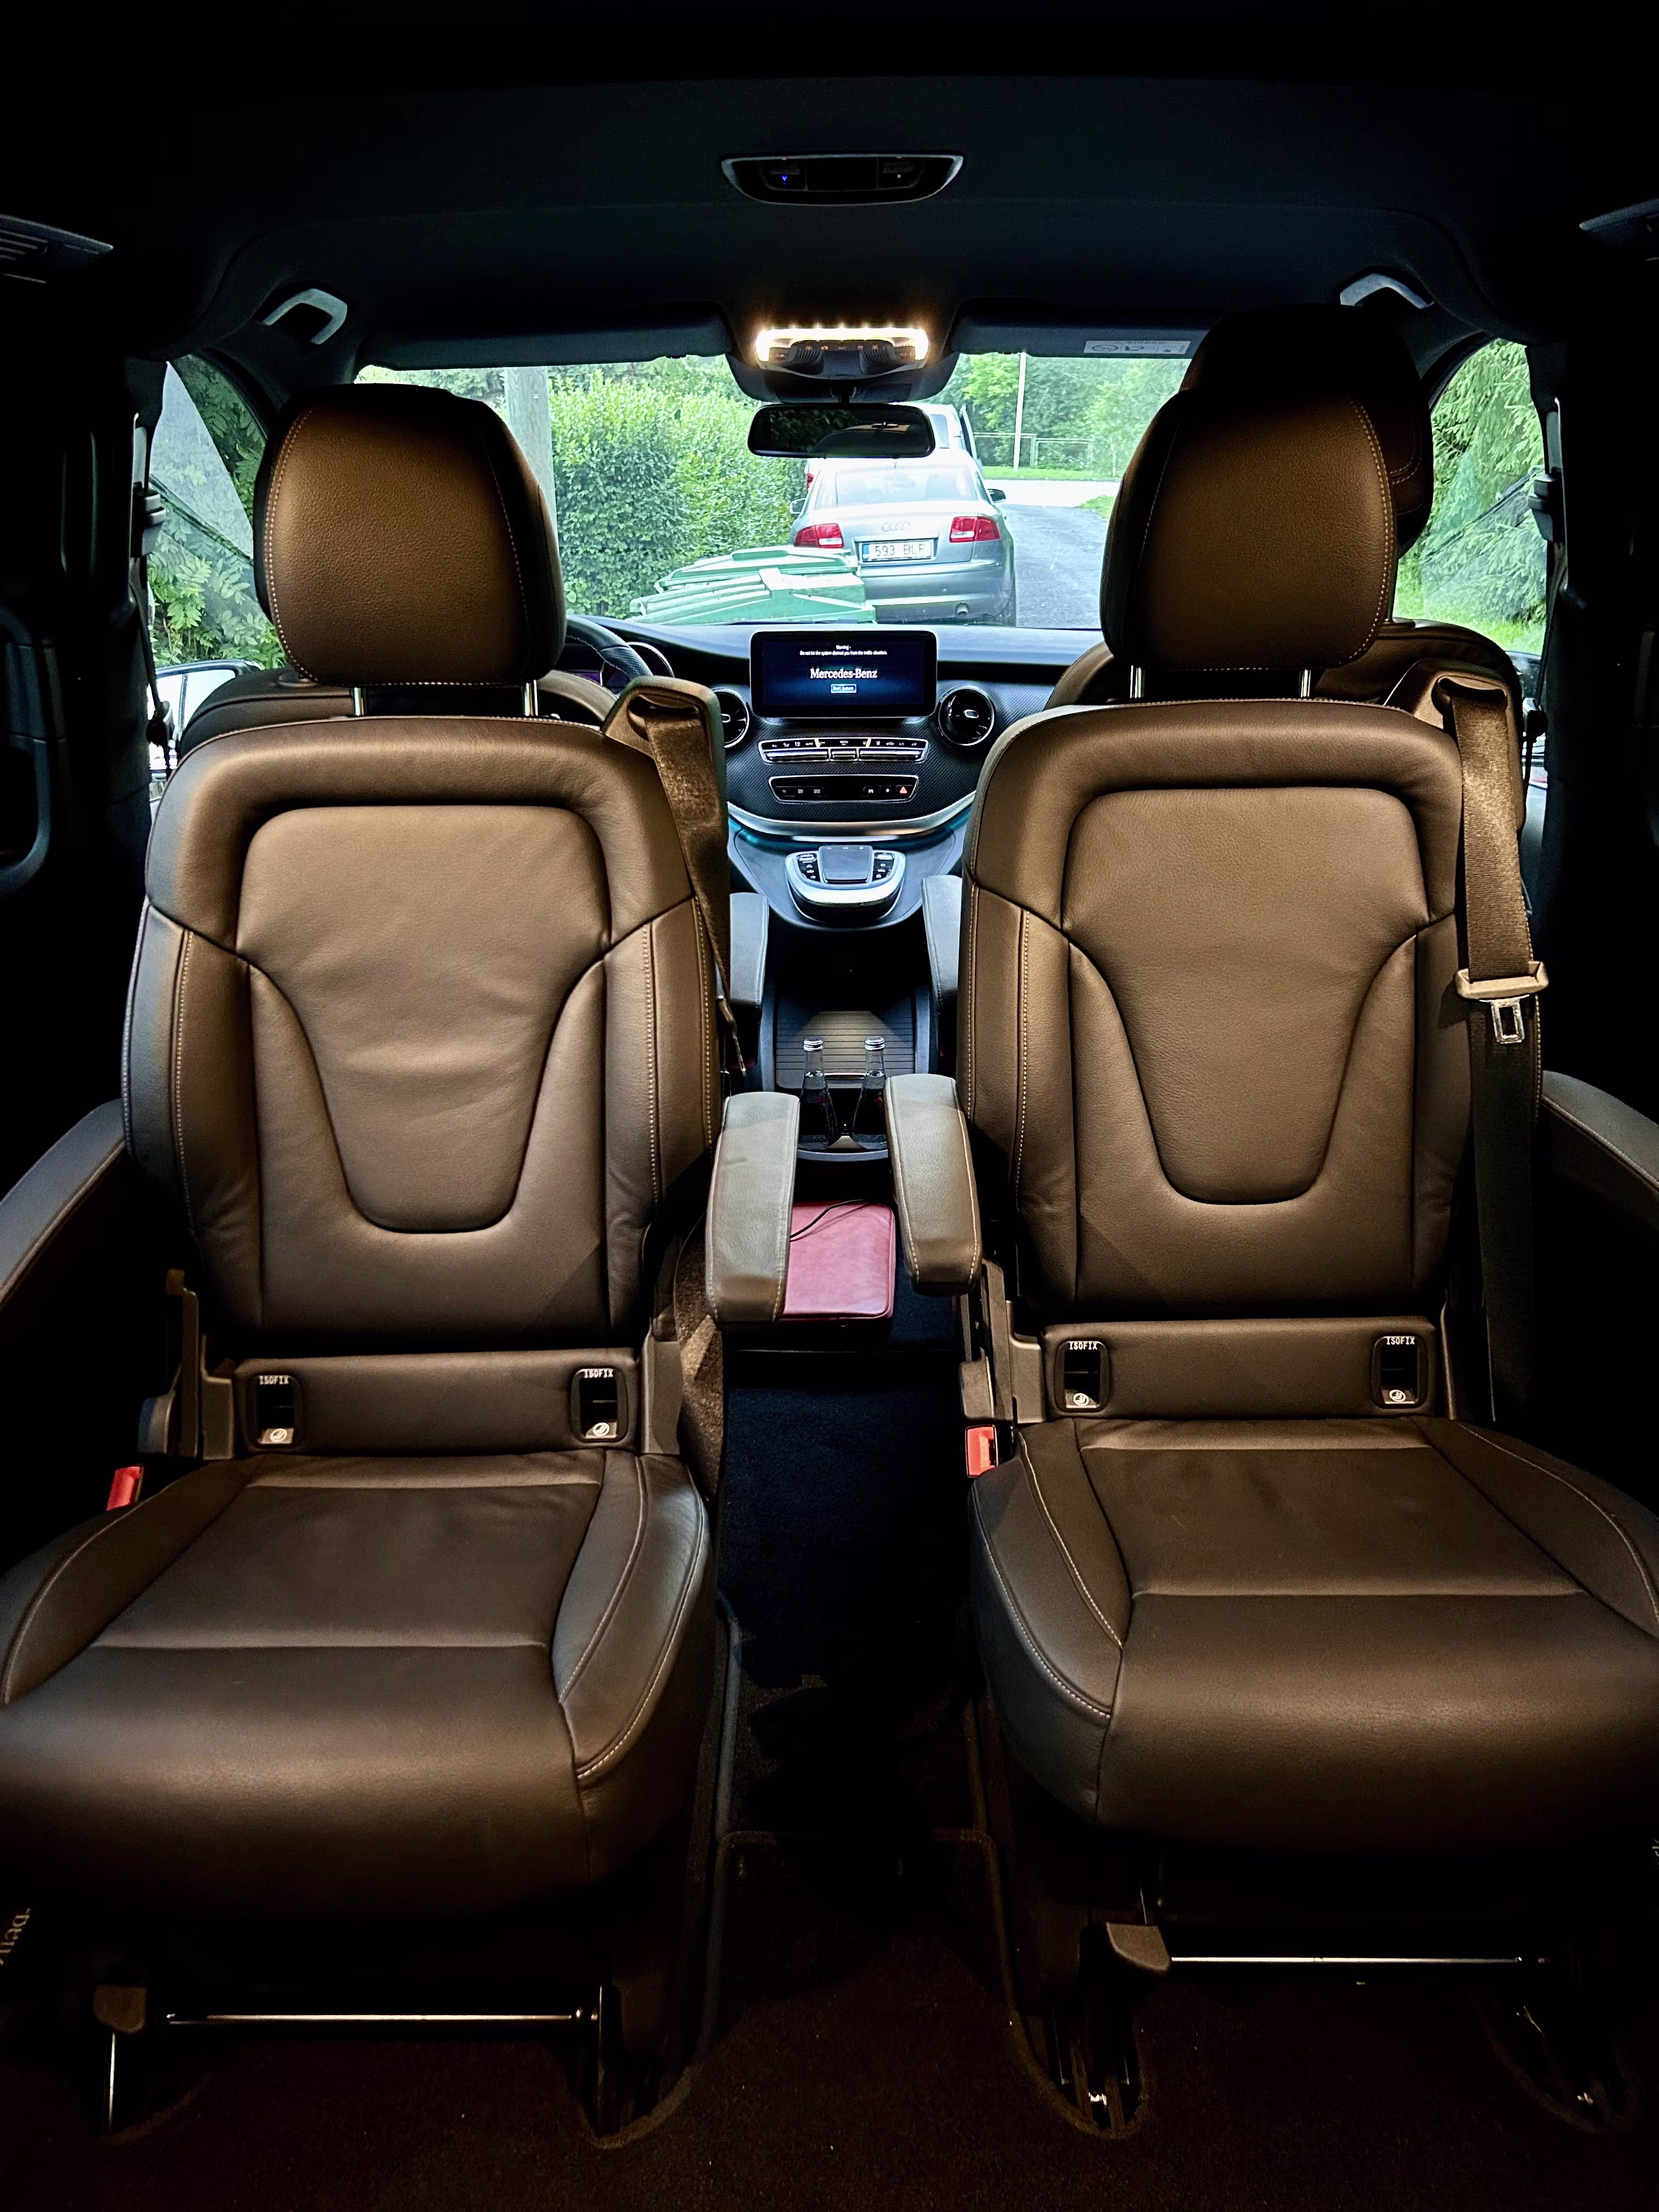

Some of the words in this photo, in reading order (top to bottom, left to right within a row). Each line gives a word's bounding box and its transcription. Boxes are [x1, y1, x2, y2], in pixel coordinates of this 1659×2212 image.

[875, 545, 895, 557] 593
[904, 543, 926, 555] BLF
[810, 667, 878, 679] Mercedes-Benz
[1069, 1341, 1098, 1350] ISOFIX
[1386, 1336, 1415, 1345] ISOFIX
[584, 1368, 613, 1378] ISOFIX
[259, 1375, 289, 1385] ISOFIX
